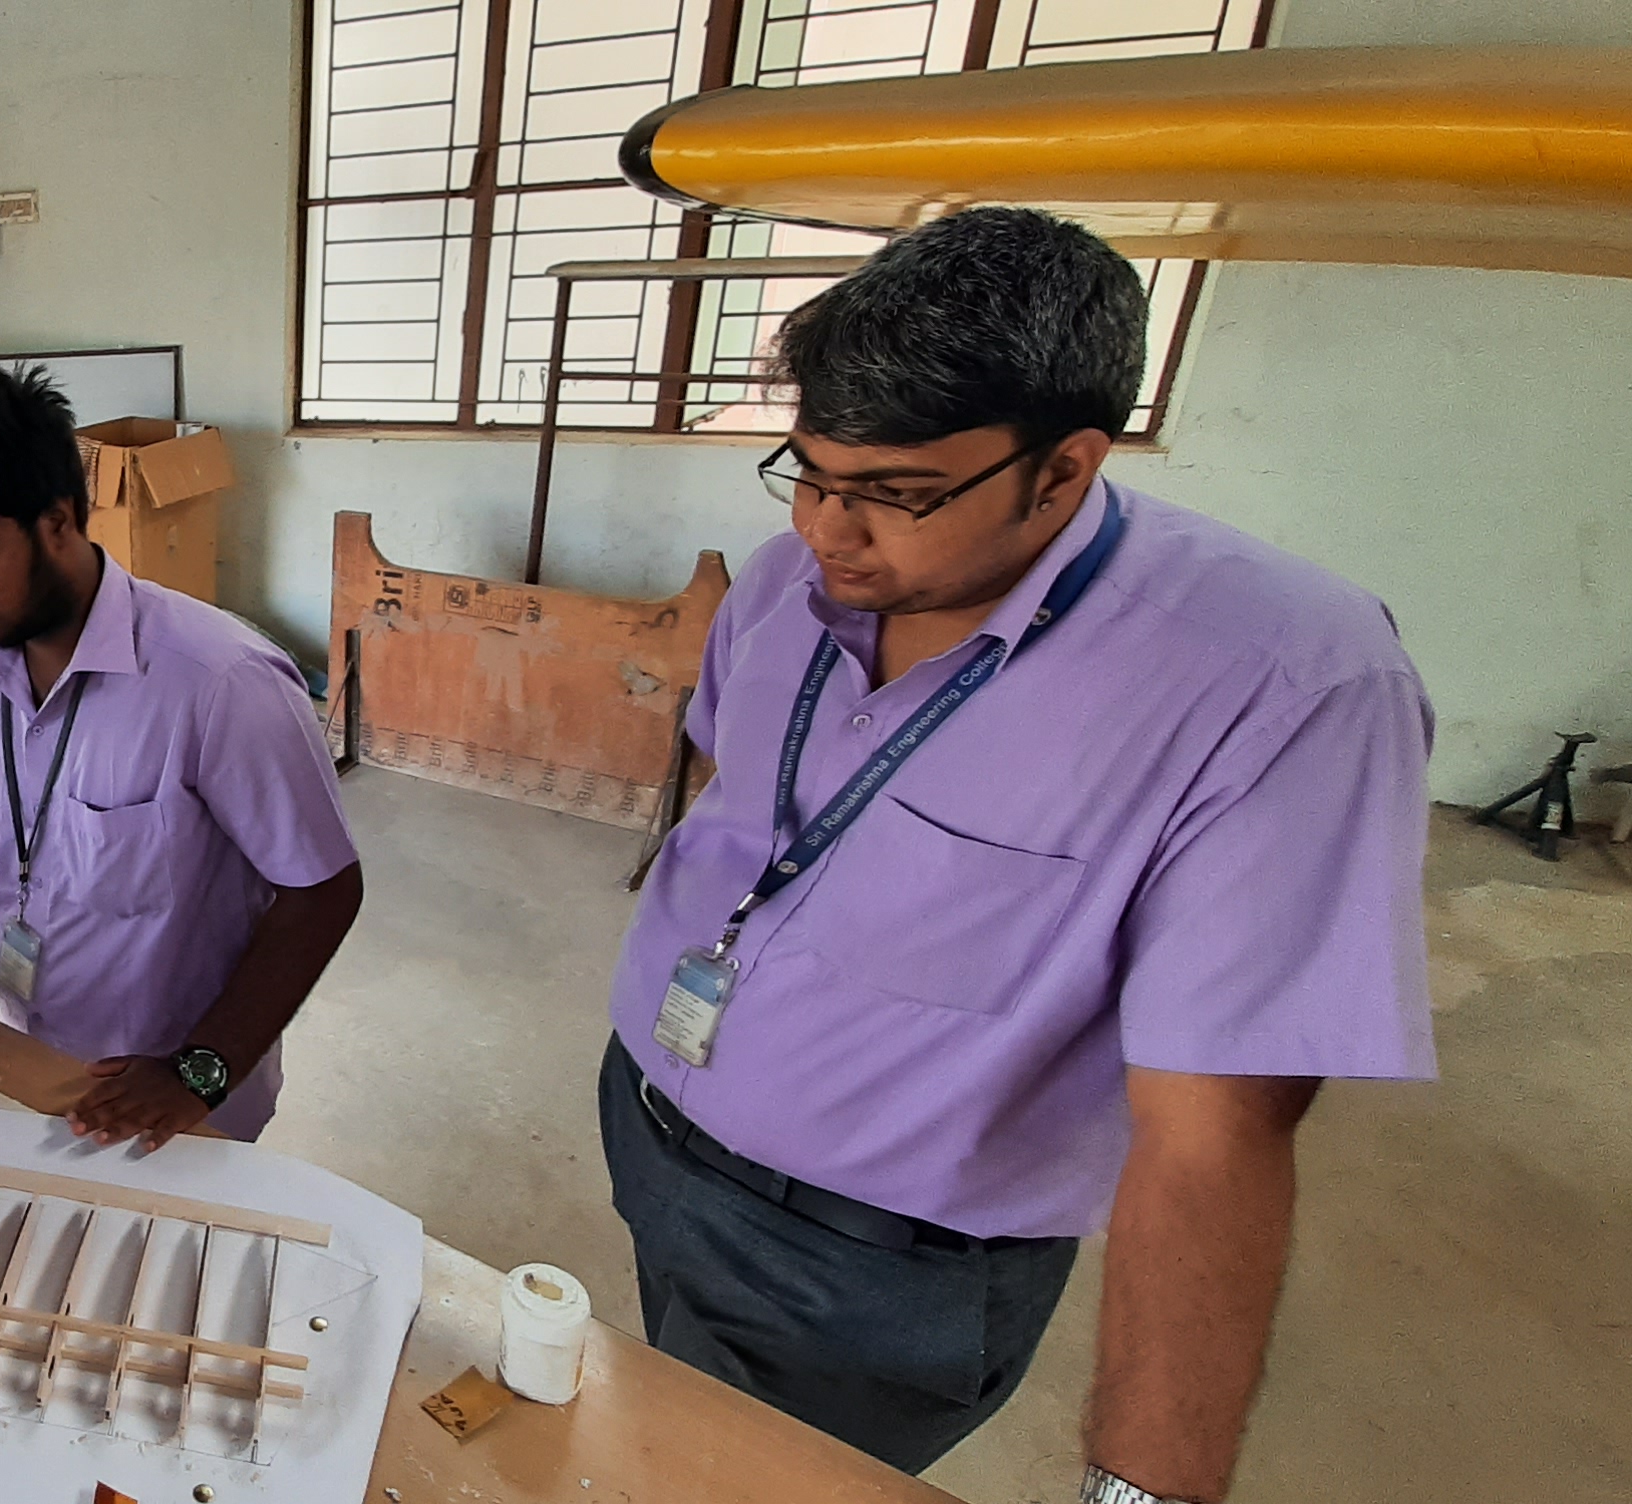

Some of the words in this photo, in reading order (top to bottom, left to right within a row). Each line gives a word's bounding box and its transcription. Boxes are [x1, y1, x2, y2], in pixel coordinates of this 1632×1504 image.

[374, 569, 404, 617] Bri
[781, 700, 811, 783] Ramakrishna
[805, 830, 826, 847] Sri
[821, 759, 889, 829] Ramakrishna
[887, 688, 961, 758] Engineering
